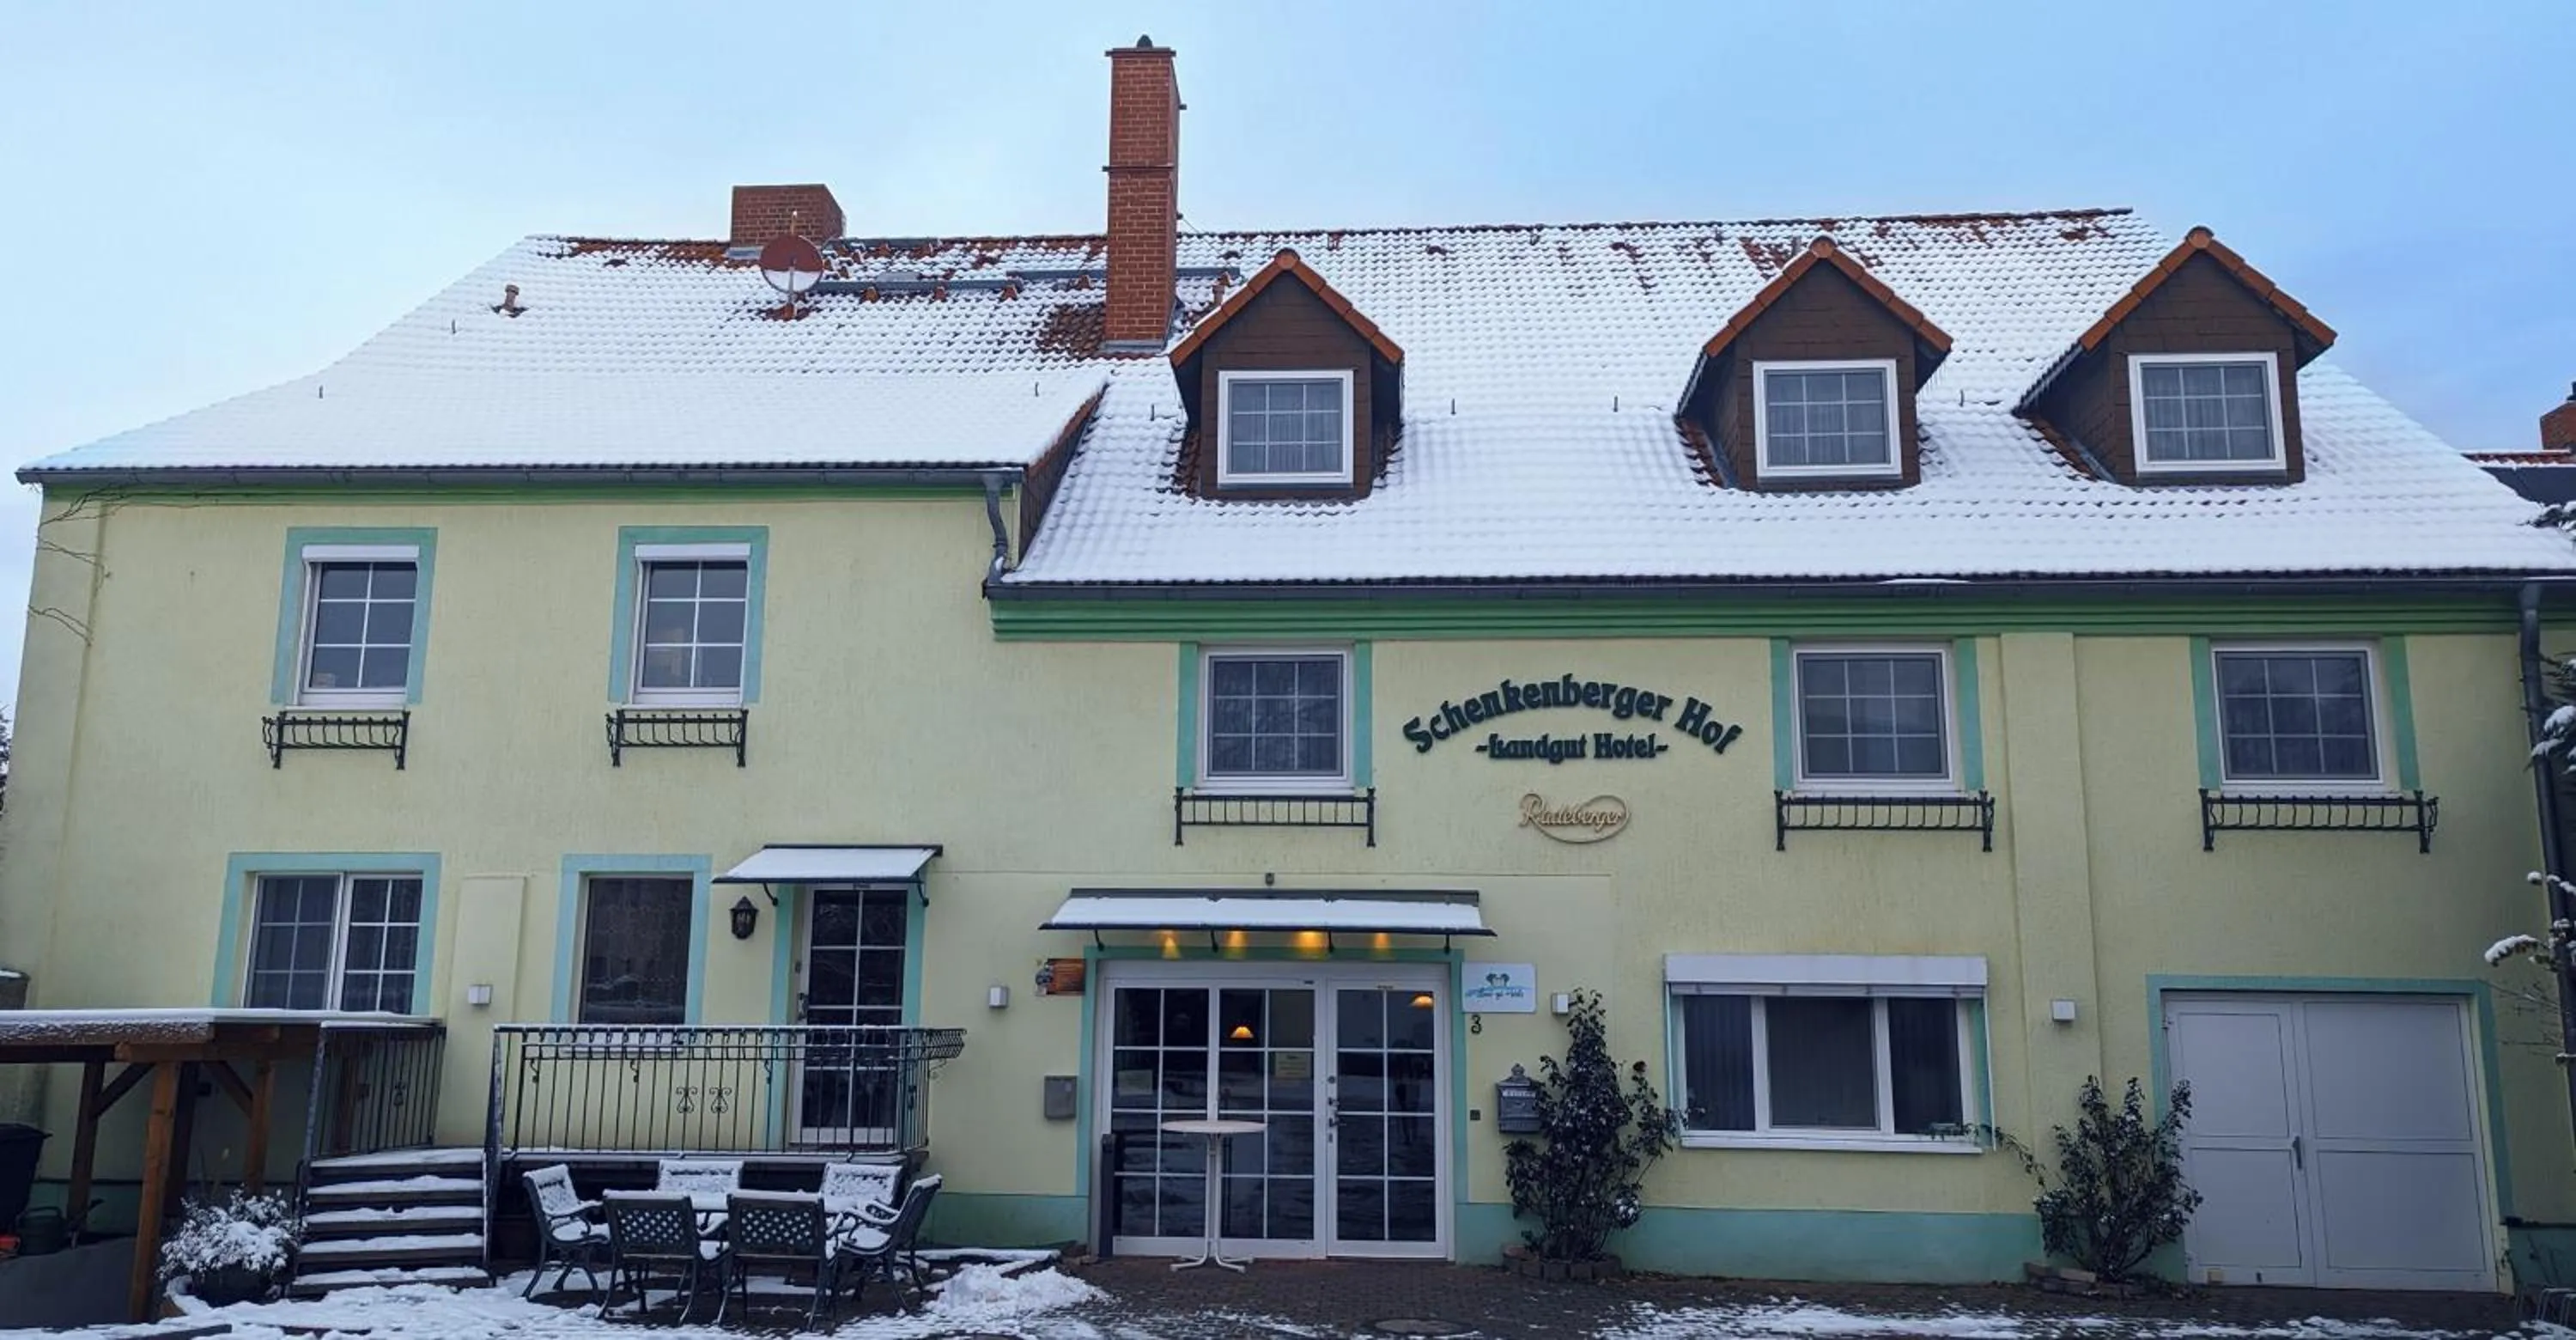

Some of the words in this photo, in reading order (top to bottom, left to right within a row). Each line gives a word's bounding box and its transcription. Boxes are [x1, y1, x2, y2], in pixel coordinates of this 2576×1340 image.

[1402, 673, 1674, 754] Schenkenberger
[1674, 697, 1743, 755] Hof
[1518, 793, 1628, 834] Radeberger
[1471, 1014, 1482, 1034] 3
